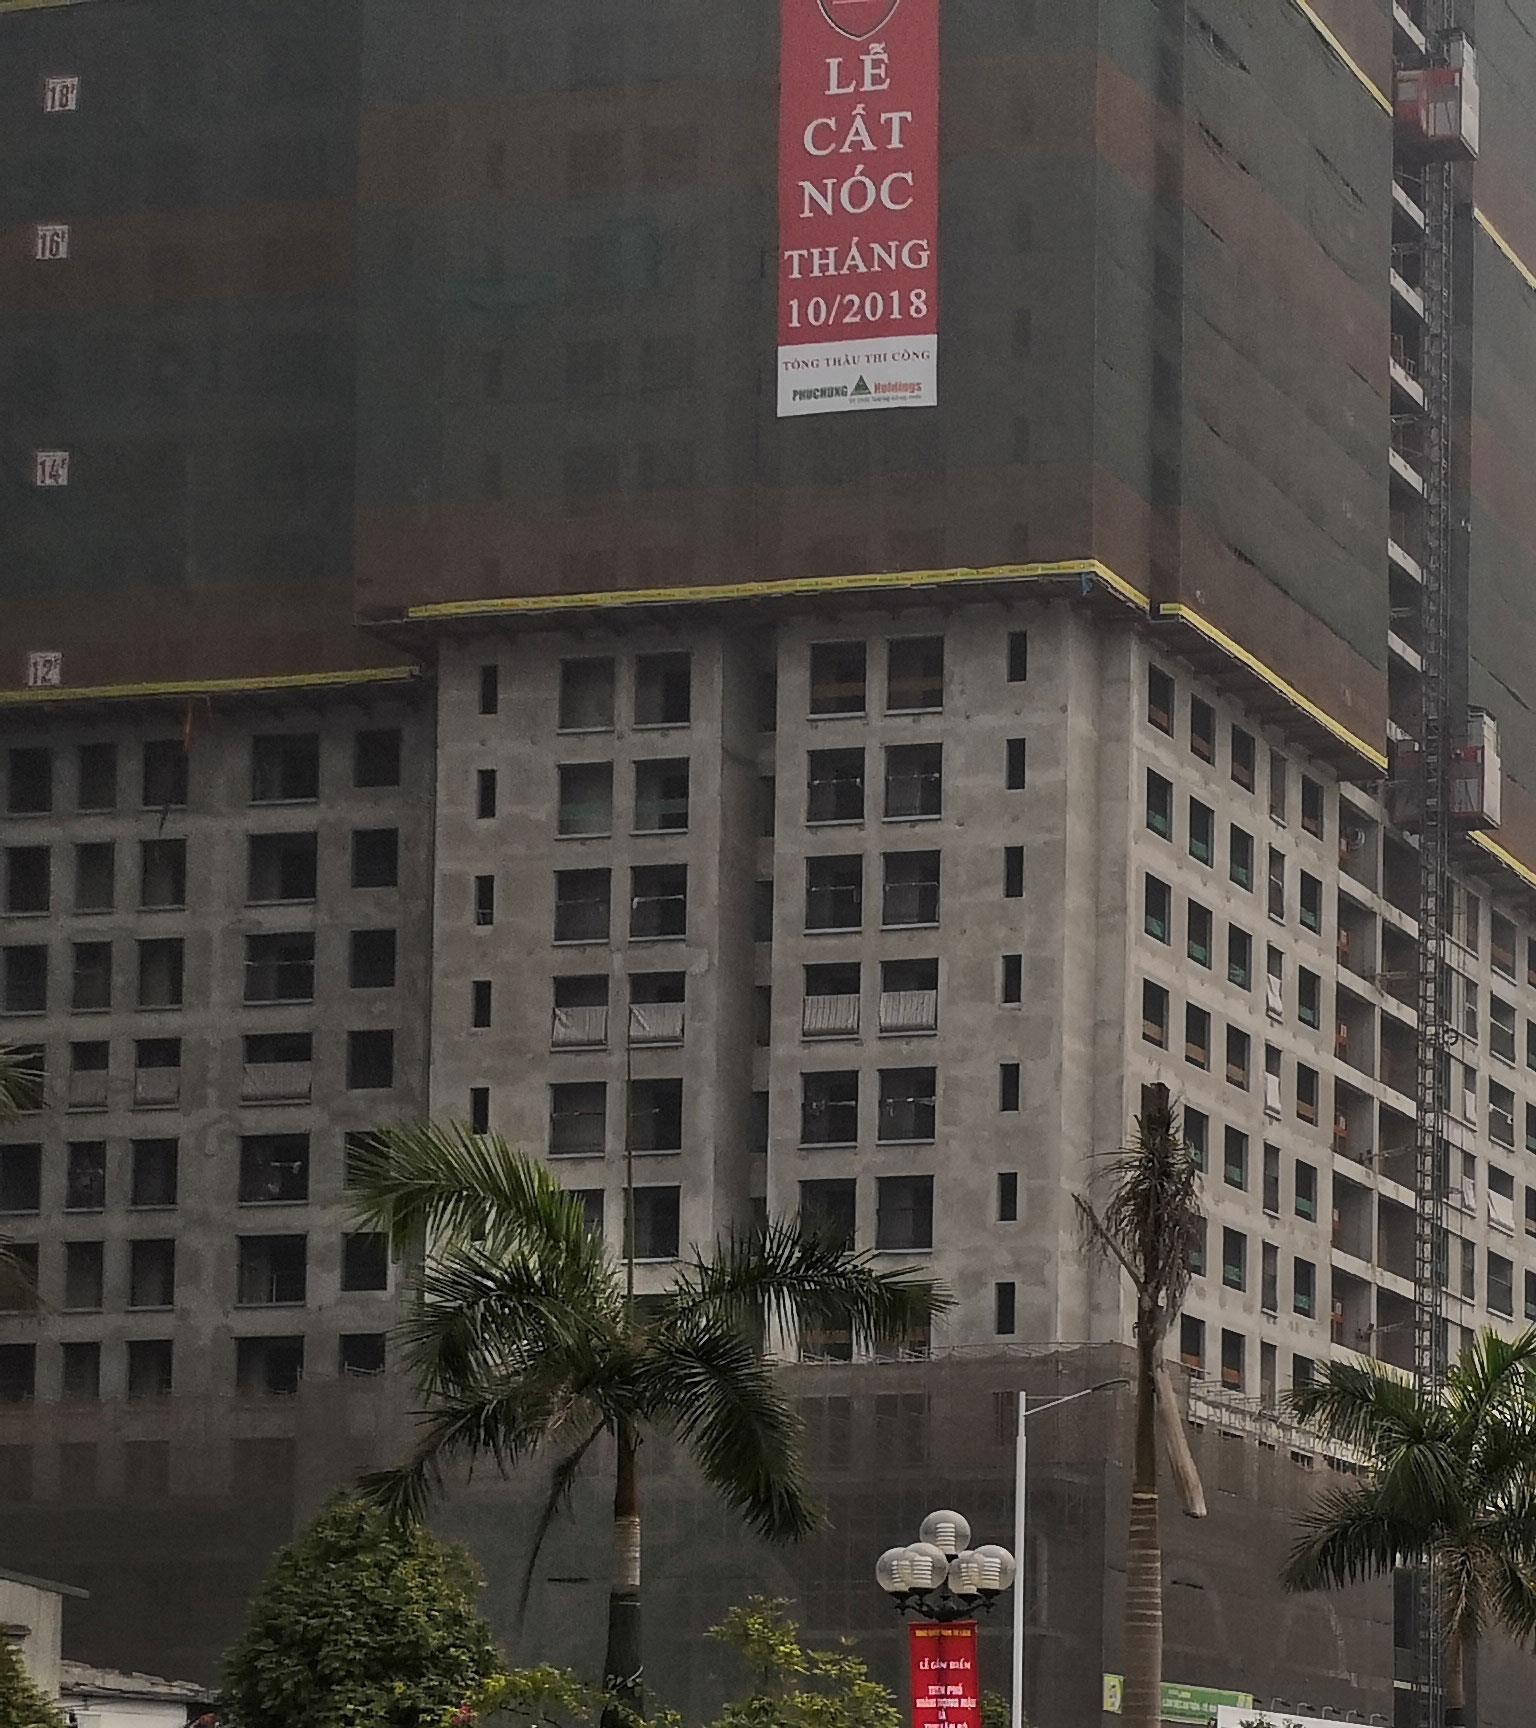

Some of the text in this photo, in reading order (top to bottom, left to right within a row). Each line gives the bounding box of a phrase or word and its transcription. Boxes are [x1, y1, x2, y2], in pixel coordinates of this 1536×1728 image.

[824, 41, 890, 96] LỄ
[803, 103, 912, 156] CẤT
[798, 164, 914, 218] NÓC
[784, 236, 931, 280] THÁNG
[788, 288, 928, 328] 10/2018
[864, 352, 888, 365] THI
[873, 379, 923, 395] Holdings
